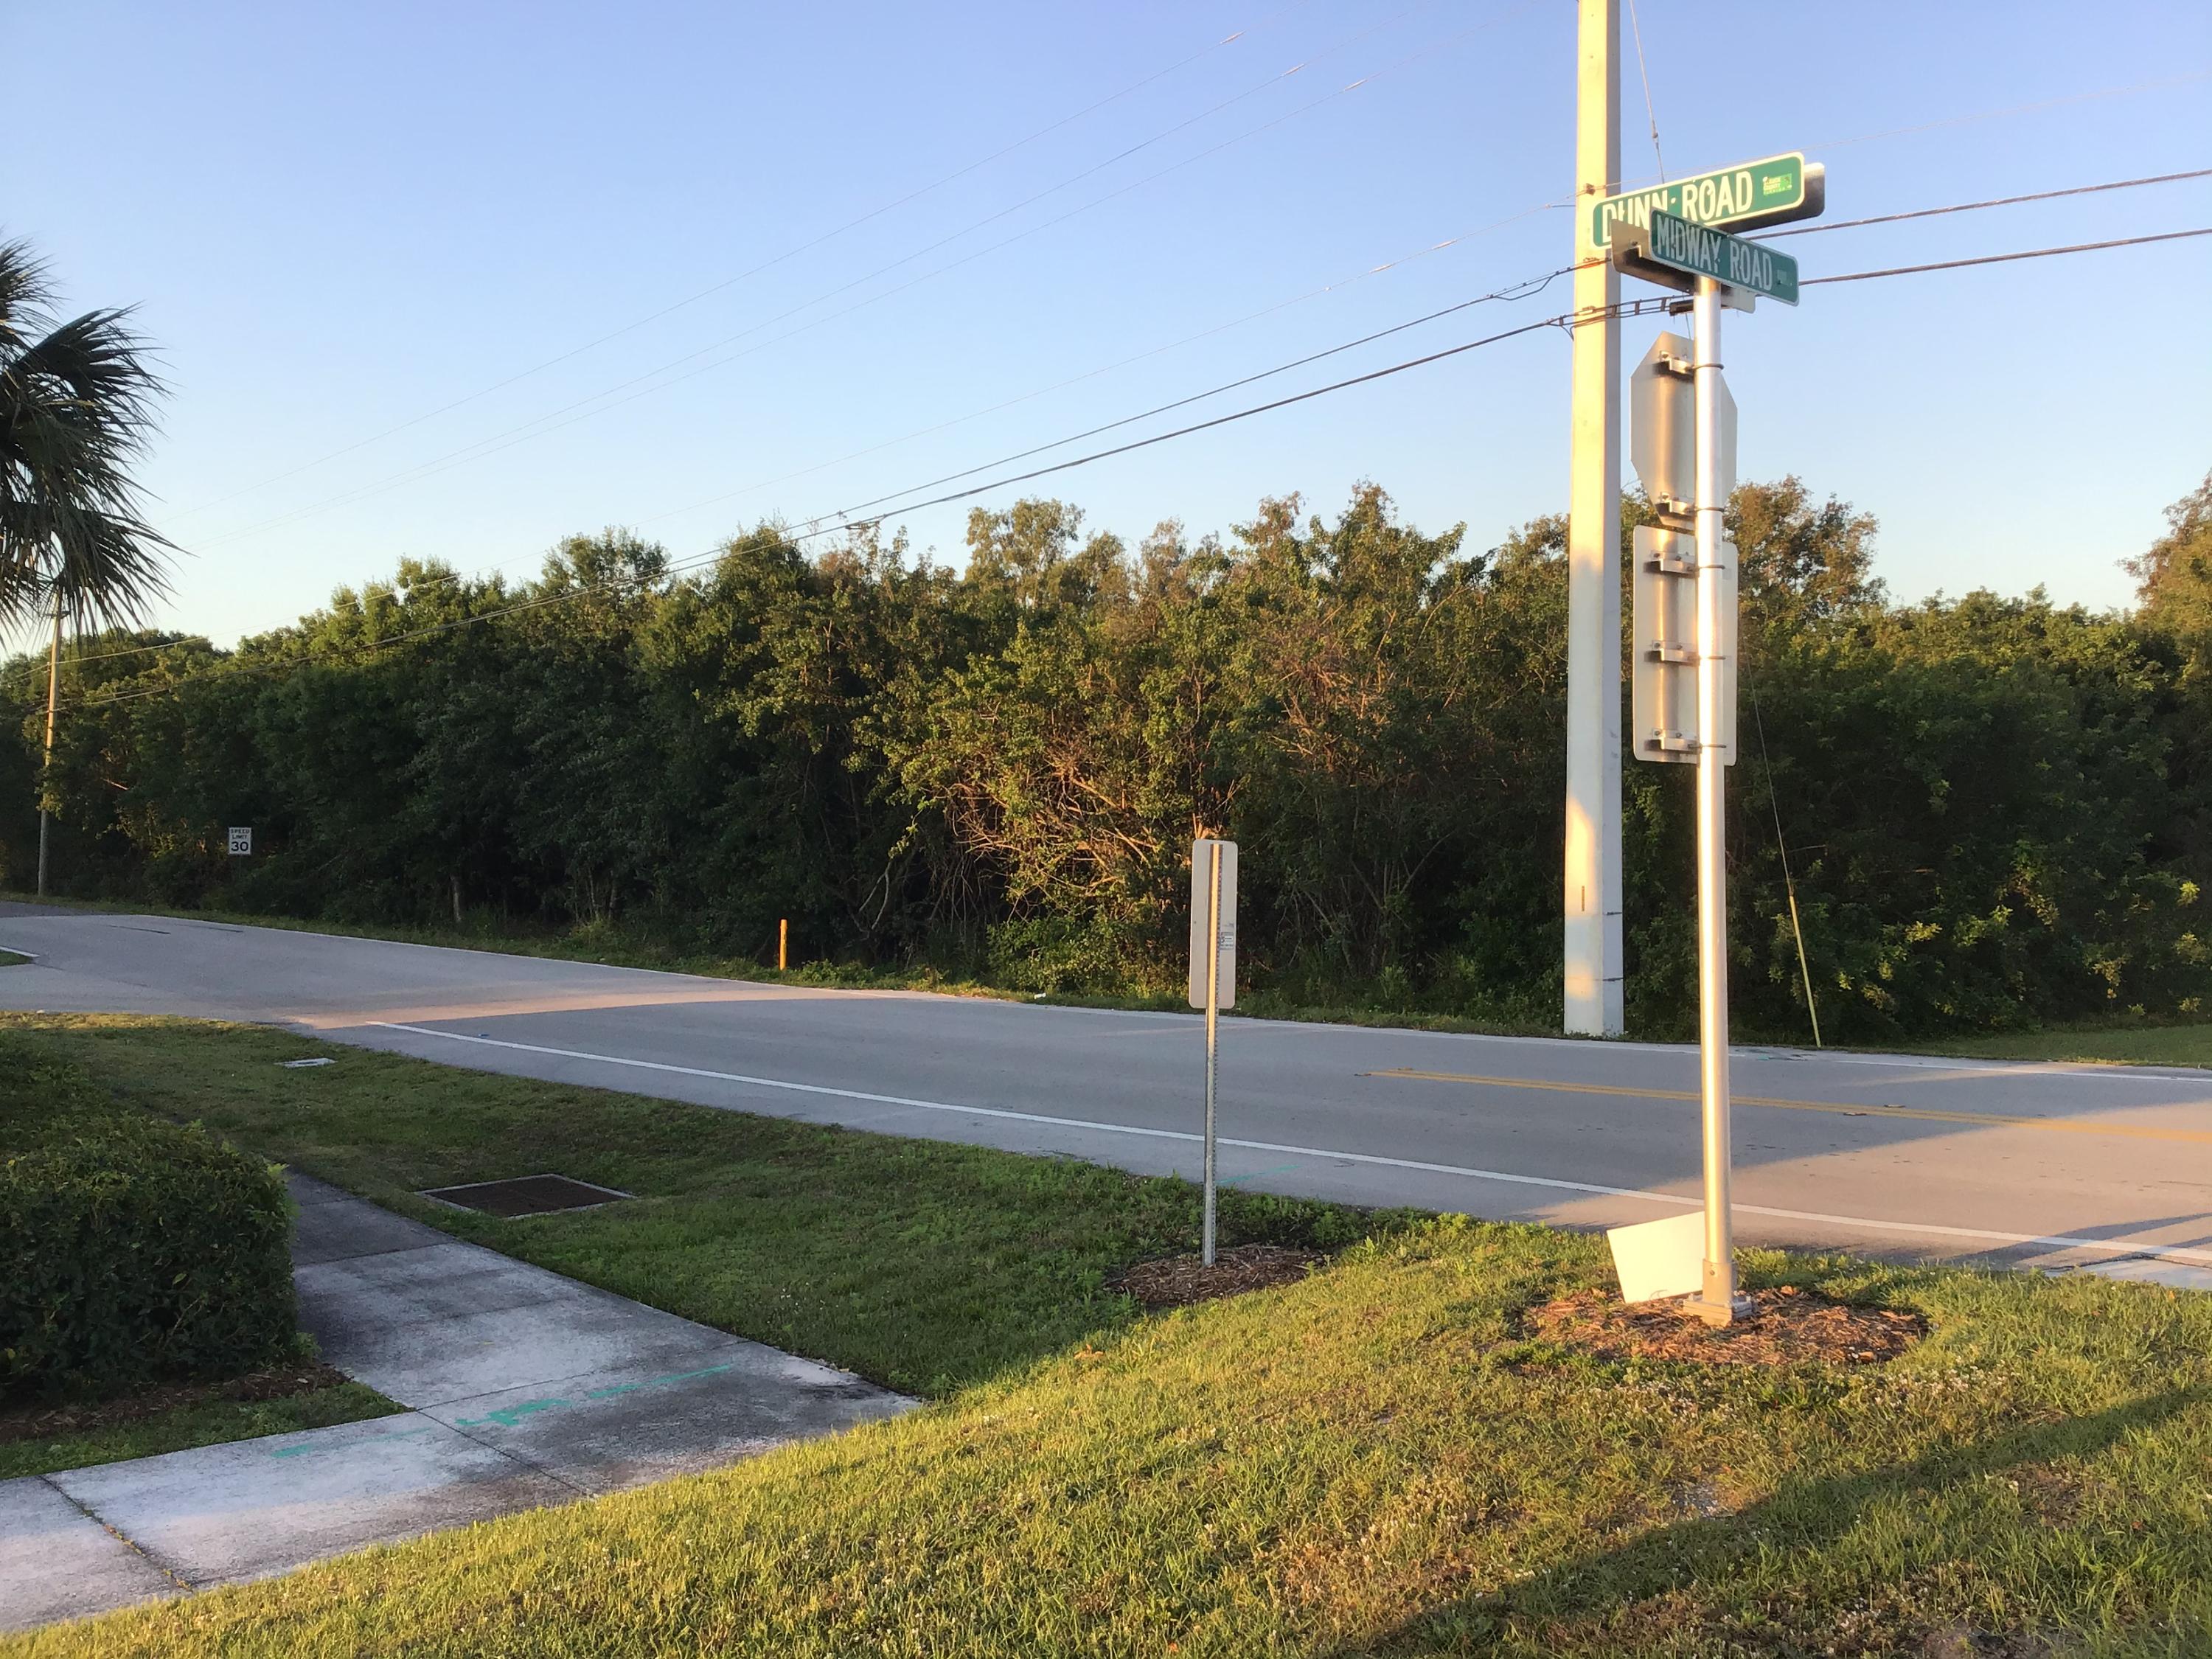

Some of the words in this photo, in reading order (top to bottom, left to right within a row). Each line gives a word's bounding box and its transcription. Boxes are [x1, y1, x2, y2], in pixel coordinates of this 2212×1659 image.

[1682, 170, 1753, 221] ROAD
[1657, 215, 1721, 274] MIDWAY
[1729, 241, 1773, 291] ROAD
[232, 841, 248, 852] 30
